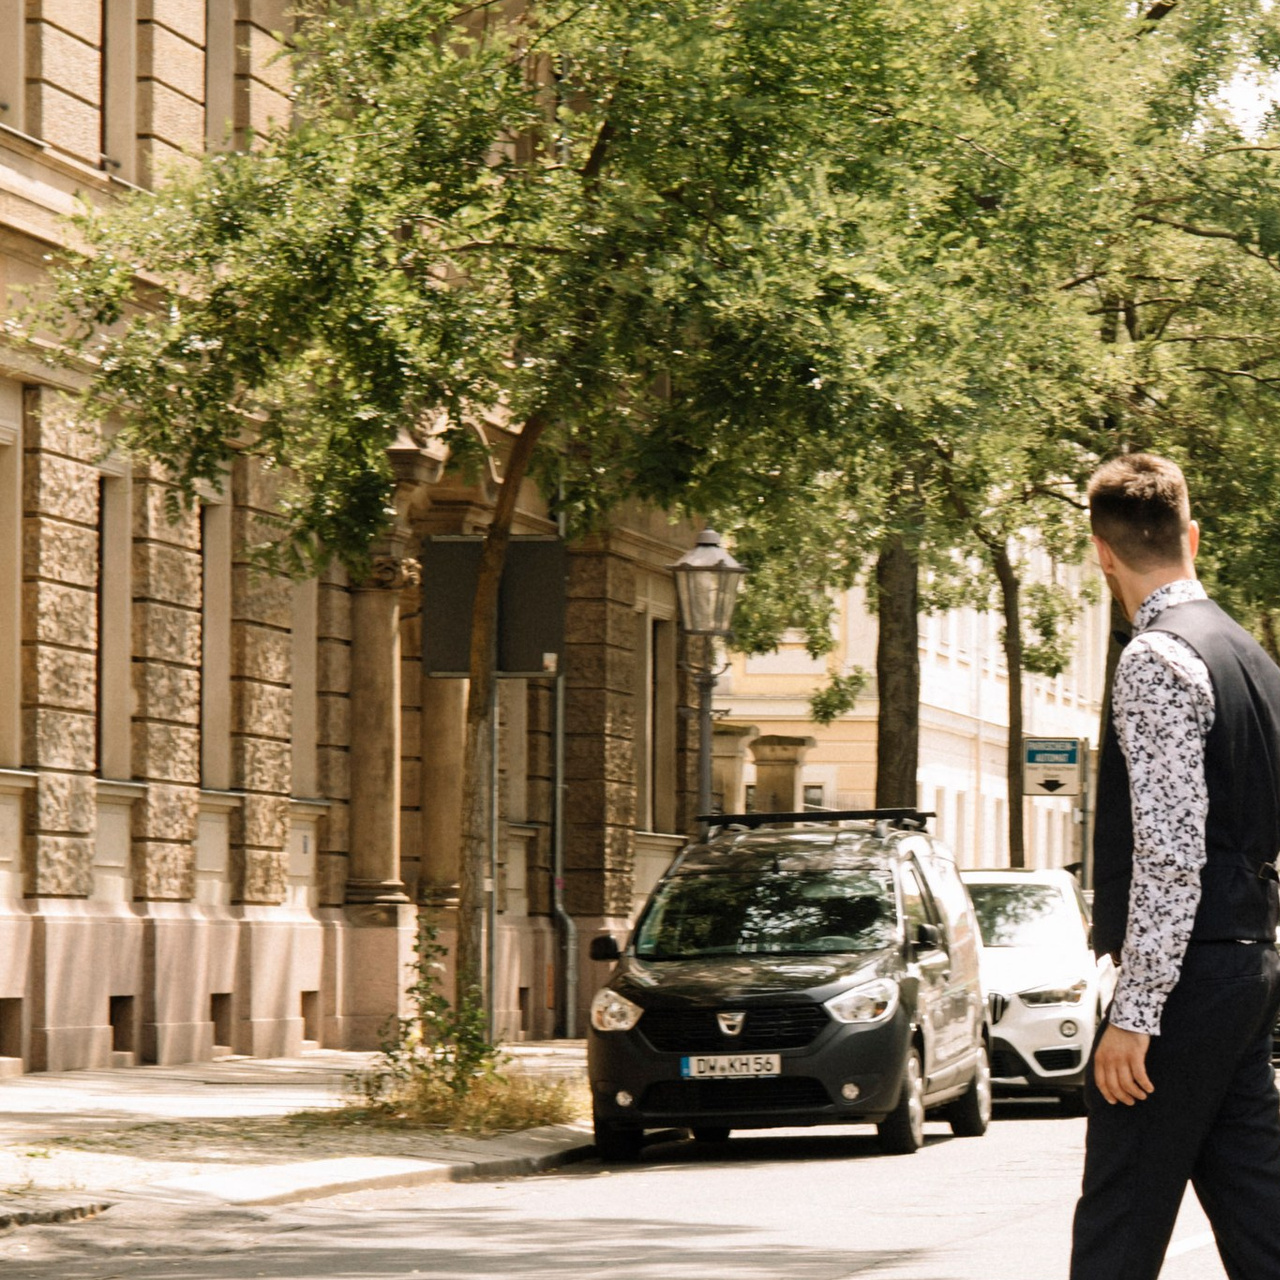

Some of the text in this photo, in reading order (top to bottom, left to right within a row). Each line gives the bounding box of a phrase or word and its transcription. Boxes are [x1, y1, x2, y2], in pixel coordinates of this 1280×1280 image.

[696, 1056, 774, 1074] DW KH 56
